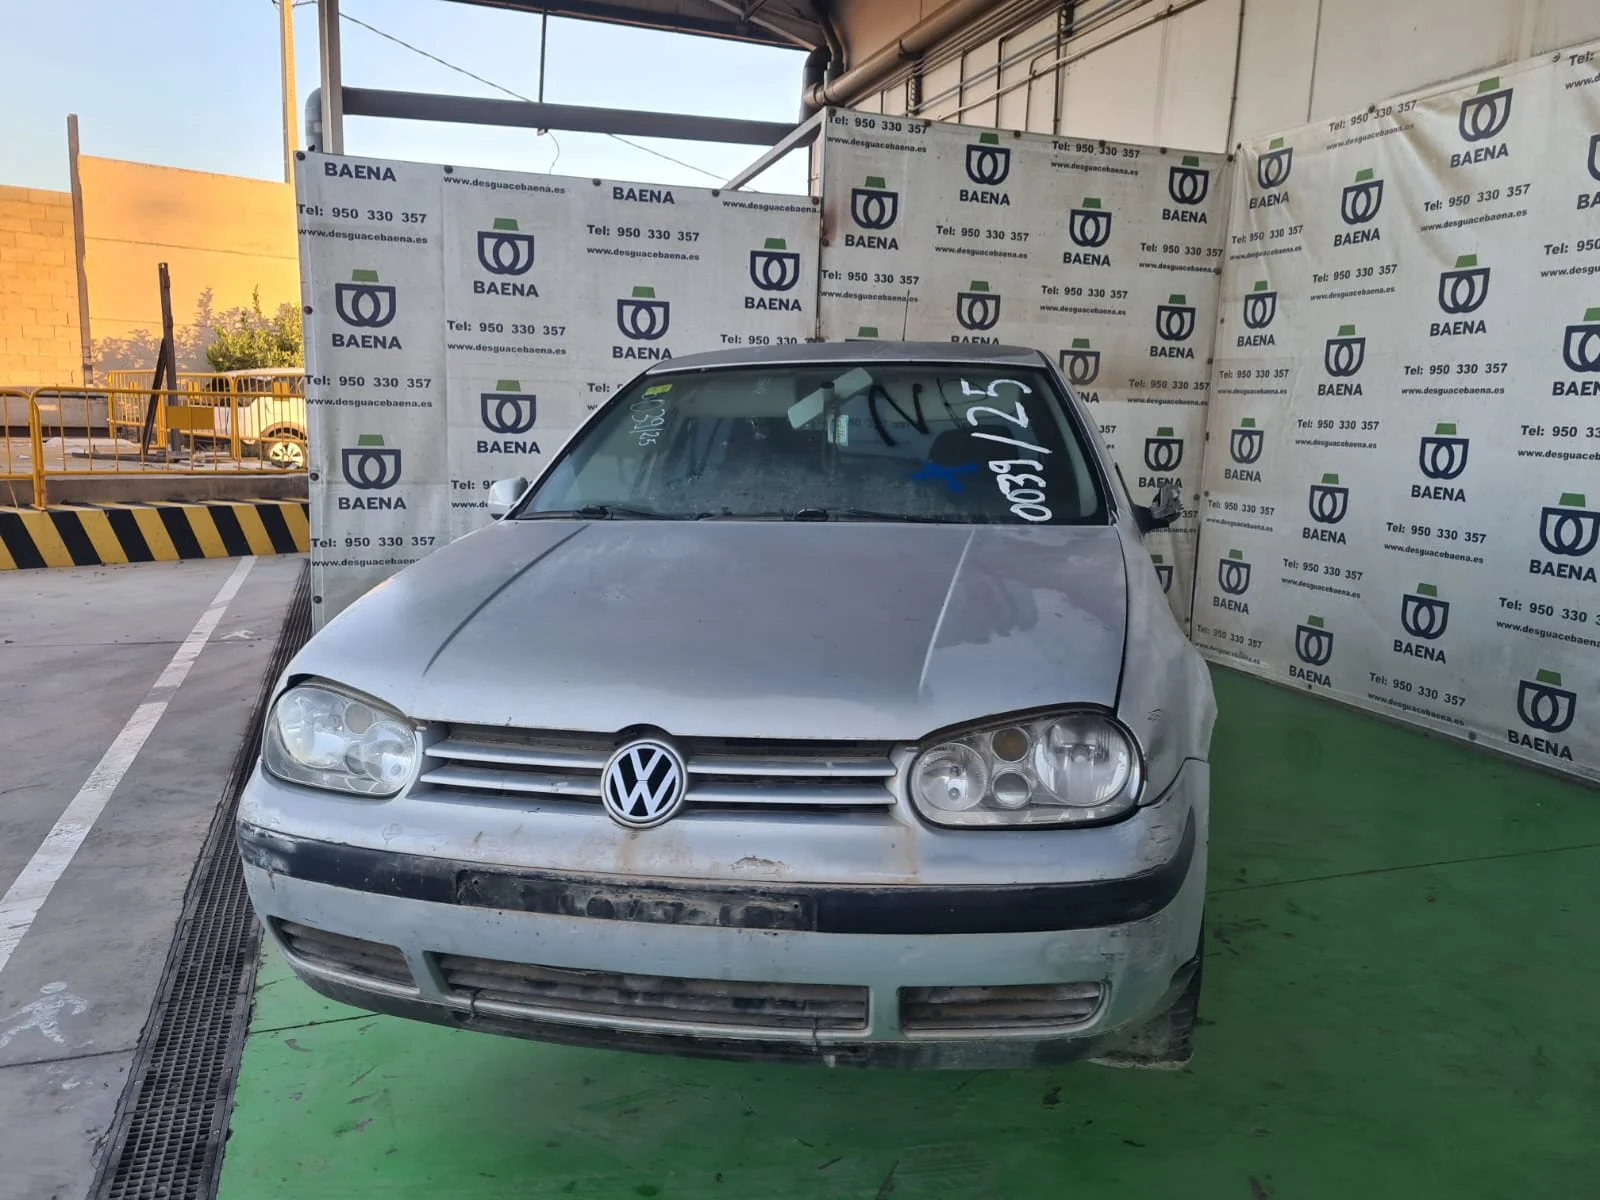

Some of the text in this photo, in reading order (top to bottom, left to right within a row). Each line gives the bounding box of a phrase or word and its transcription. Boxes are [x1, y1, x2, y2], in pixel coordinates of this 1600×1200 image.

[1568, 52, 1594, 66] Tel:
[1329, 100, 1417, 132] Tel: 950 330 357
[829, 115, 927, 135] Tel: 950 330 357
[1051, 141, 1070, 151] Tel:
[1075, 143, 1094, 154] 950
[1122, 148, 1140, 159] 357
[1450, 143, 1509, 168] BAENA
[324, 162, 396, 181] BAENA
[612, 187, 675, 204] BAENA
[960, 190, 1010, 206] BAENA
[1249, 191, 1290, 209] BAENA
[1424, 184, 1531, 212] Tel: 950 330 357
[298, 204, 427, 224] Tel: 950 330 357
[1162, 209, 1207, 224] BAENA
[586, 225, 699, 242] Tel: 950 330 357
[936, 225, 1029, 242] Tel: 950 330 357
[1232, 235, 1247, 244] Tel:
[1270, 229, 1284, 239] 330
[1288, 225, 1303, 236] 357
[1334, 228, 1380, 247] BAENA
[845, 234, 899, 250] BAENA
[1140, 243, 1223, 257] Tel: 950 330 357
[1544, 244, 1568, 256] Tel:
[1062, 252, 1111, 267] BAENA
[820, 269, 919, 286] Tel: 950 330 357
[1312, 264, 1397, 284] Tel: 950 330 357
[473, 281, 539, 297] BAENA
[1041, 285, 1128, 300] Tel: 950 330 357
[744, 296, 802, 311] BAENA
[447, 320, 566, 336] Tel: 950 330 357
[1430, 320, 1487, 337] BAENA
[331, 333, 402, 350] BAENA
[720, 334, 769, 346] Tel: 950
[1237, 334, 1275, 347] BAENA
[612, 345, 672, 361] BAENA
[1150, 346, 1194, 359] BAENA
[1237, 370, 1251, 378] 950
[1255, 369, 1270, 378] 330
[1274, 369, 1289, 378] 357
[1404, 363, 1507, 376] Tel: 950 330 357
[305, 375, 431, 389] Tel: 950 330 357
[587, 383, 610, 394] Tel:
[1129, 379, 1209, 391] Tel: 950 330 357
[1317, 384, 1363, 396] BAENA
[1099, 425, 1117, 434] 357
[1297, 419, 1379, 430] Tel: 950 330 357
[1521, 425, 1577, 437] Tel: 950
[477, 440, 540, 454] BAENA
[960, 378, 1053, 521] 0039/25
[1224, 468, 1261, 482] BAENA
[451, 480, 475, 490] Tel:
[1411, 484, 1466, 502] BAENA
[337, 497, 407, 510] BAENA
[1208, 499, 1274, 515] Tel: 950 330 357
[1302, 527, 1347, 545] BAENA
[1386, 522, 1487, 544] Tel: 950 330 357
[310, 536, 435, 549] Tel: 950 330 357
[1283, 558, 1363, 581] Tel: 950 330 357
[1529, 559, 1598, 583] BAENA
[1212, 596, 1249, 615] BAENA
[1498, 597, 1522, 611] Tel:
[1529, 603, 1554, 617] 950
[1561, 609, 1587, 623] 330
[1393, 639, 1447, 664] BAENA
[1289, 665, 1332, 688] BAENA
[1369, 672, 1466, 708] Tel: 950 330 357
[1507, 729, 1573, 761] BAENA
